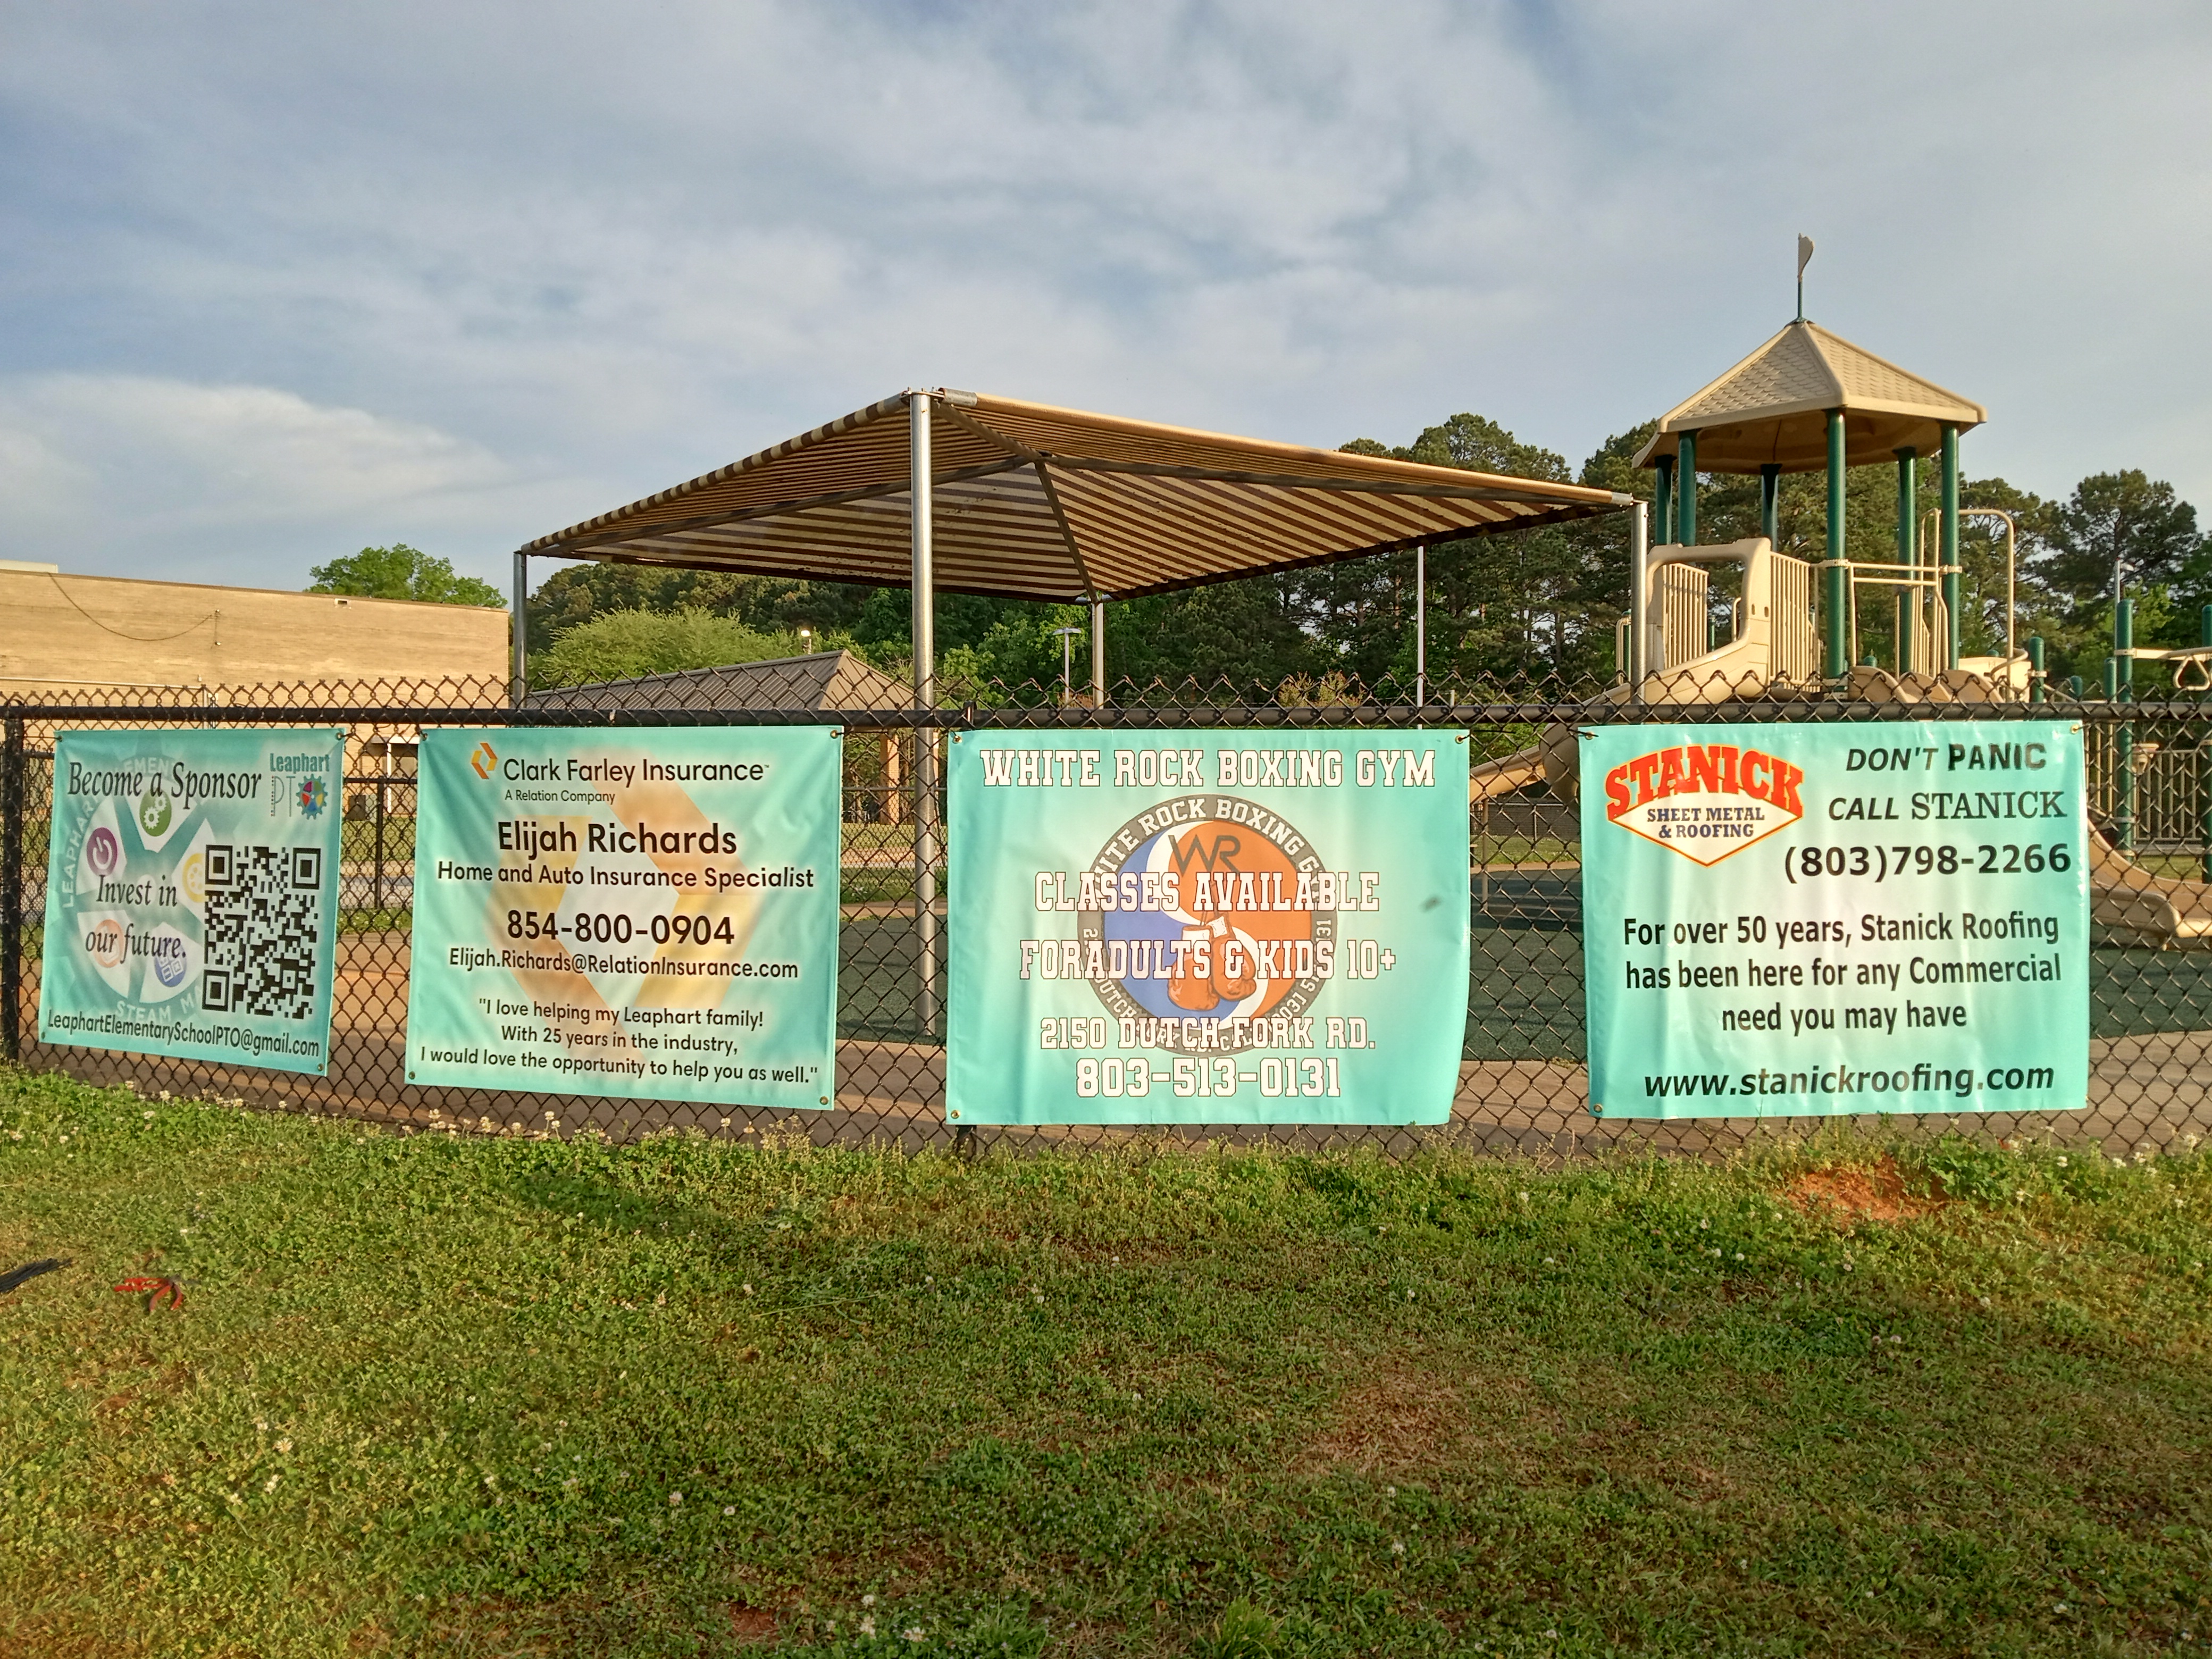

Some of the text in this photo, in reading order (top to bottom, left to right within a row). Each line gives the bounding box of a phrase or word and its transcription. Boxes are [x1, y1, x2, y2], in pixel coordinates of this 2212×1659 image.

[270, 753, 330, 774] Leaphart
[504, 758, 562, 781] Clark
[567, 758, 636, 788] Farley
[981, 749, 1436, 787] WHITE ROCK BOXING GYM
[1846, 742, 2046, 772] DON'T PANIC
[68, 762, 143, 797] Become
[150, 771, 163, 797] a
[171, 761, 262, 810] Sponsor
[505, 789, 615, 805] A Relation Company
[1605, 745, 1804, 821] STANICK
[1647, 807, 1765, 822] SHEET METAL
[1829, 791, 2068, 821] CALL STANICK
[498, 820, 737, 861] Elijah Richards
[1138, 798, 1206, 836] ROCK
[1215, 799, 1305, 856] BOXING
[1658, 824, 1754, 839] & ROOFING
[438, 861, 814, 893] Home and Auto Insurance Specialist
[1785, 843, 2071, 884] (803)798-2266
[96, 874, 178, 907] Invest in
[1035, 872, 1180, 912] CLASSES
[1193, 872, 1380, 912] AVAILABLE
[85, 923, 186, 964] our future.
[507, 909, 735, 945] 854-800-0904
[1624, 910, 2059, 950] For over 50 years, Stanick Roofing
[450, 947, 798, 978] Elijah.Richards@RelationInsurance.com
[1224, 940, 1244, 979] &
[1257, 940, 1334, 979] KIDS
[1347, 940, 1396, 979] 10+
[1626, 953, 2061, 991] has been here for any Commercial
[47, 1009, 320, 1057] LeaphartElementarySchoolPTO@gmail.com
[479, 998, 763, 1032] "I love helping my Leaphart family!
[1722, 1000, 1967, 1037] need you may have
[501, 1025, 738, 1057] With 25 years in the industry,
[1041, 1018, 1106, 1049] 2150
[1118, 1018, 1219, 1049] DUTCH
[1232, 1018, 1314, 1049] FORK
[1326, 1018, 1376, 1049] RD.
[421, 1046, 817, 1083] I would love the opportunity to help you as well."
[1076, 1058, 1340, 1097] 803-513-0131
[1644, 1063, 2054, 1098] www.stanickroofing.com
